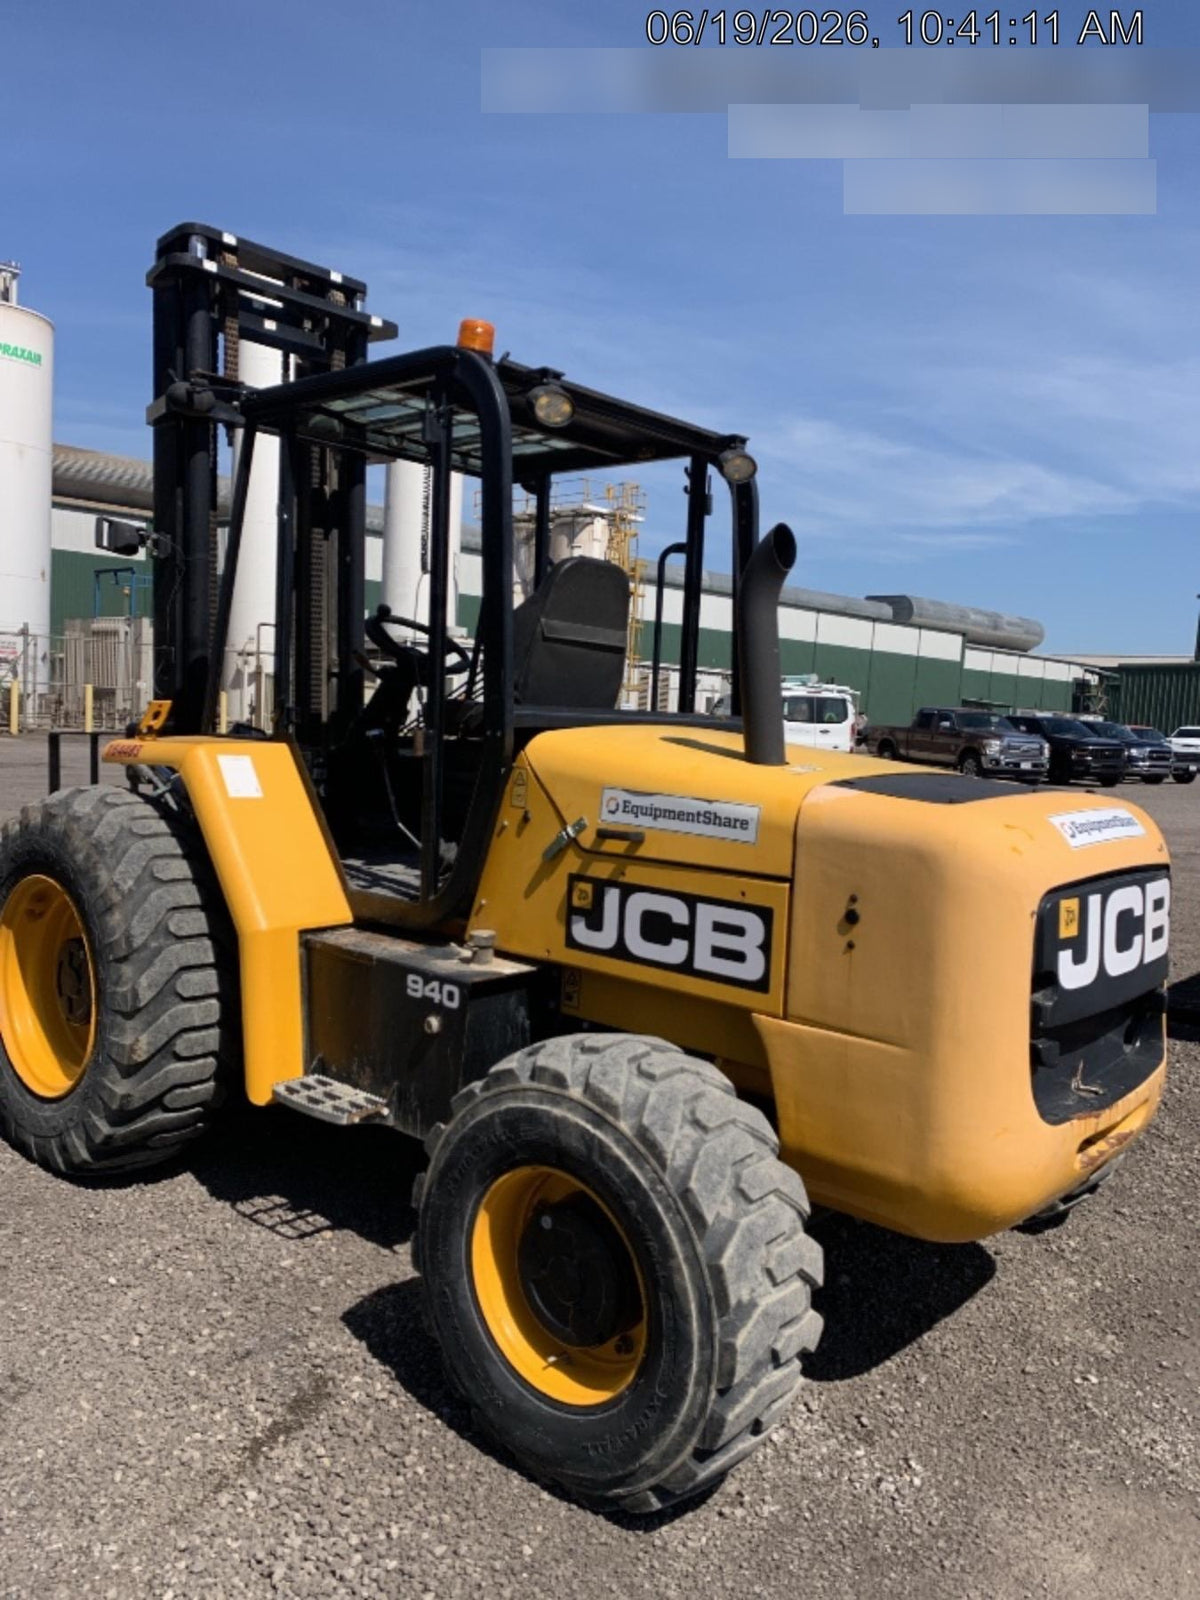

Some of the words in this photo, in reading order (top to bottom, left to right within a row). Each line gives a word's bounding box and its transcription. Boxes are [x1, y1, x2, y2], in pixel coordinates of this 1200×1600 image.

[0, 342, 42, 367] RAXAIR
[621, 799, 750, 831] EquipmentShare
[571, 886, 766, 982] JCB
[1058, 878, 1170, 990] JCB
[406, 973, 460, 1009] 940
